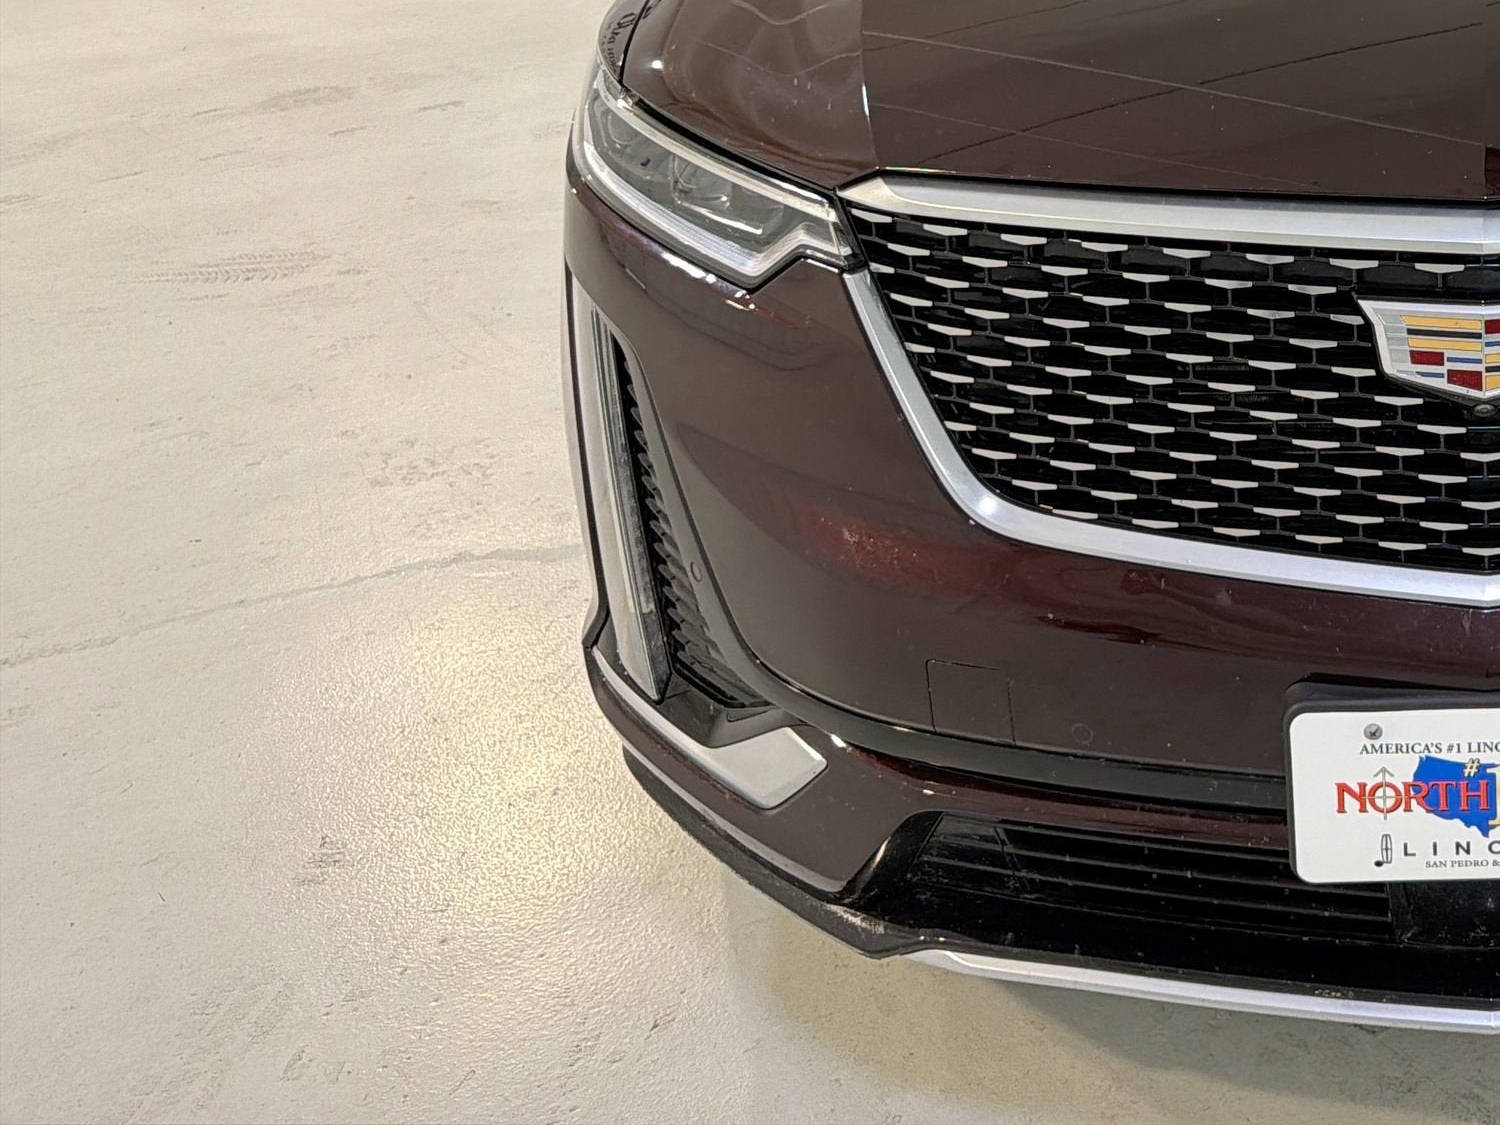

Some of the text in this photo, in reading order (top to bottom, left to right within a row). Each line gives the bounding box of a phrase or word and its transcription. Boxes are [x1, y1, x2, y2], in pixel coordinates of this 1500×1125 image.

[1360, 741, 1442, 755] AMERICA'S
[1446, 742, 1462, 754] #1
[1335, 778, 1489, 813] NORTH
[1425, 859, 1447, 868] SAN
[1450, 858, 1489, 868] PEDRO
[1492, 858, 1500, 867] &
